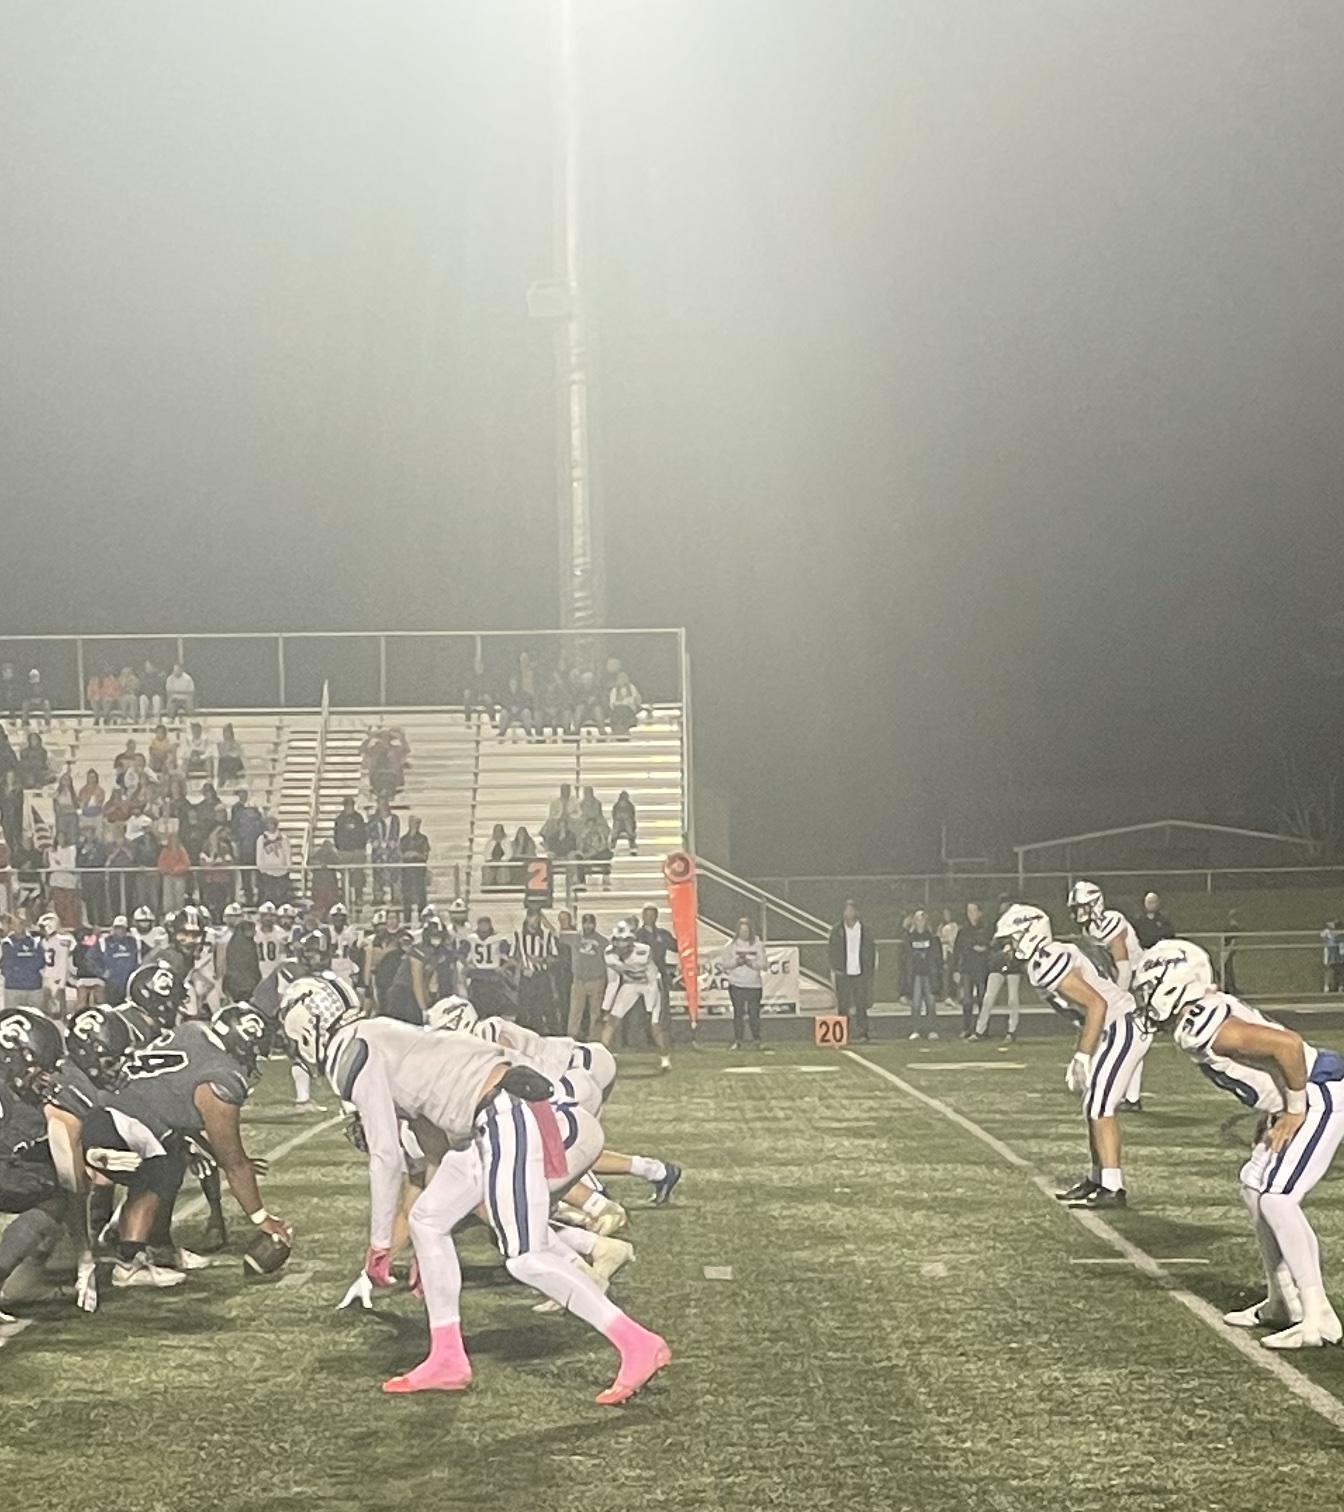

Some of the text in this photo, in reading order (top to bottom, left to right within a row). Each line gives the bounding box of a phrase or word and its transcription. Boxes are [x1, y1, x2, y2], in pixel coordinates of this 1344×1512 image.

[527, 862, 548, 889] 2
[474, 944, 493, 964] 51
[819, 1021, 844, 1043] 20
